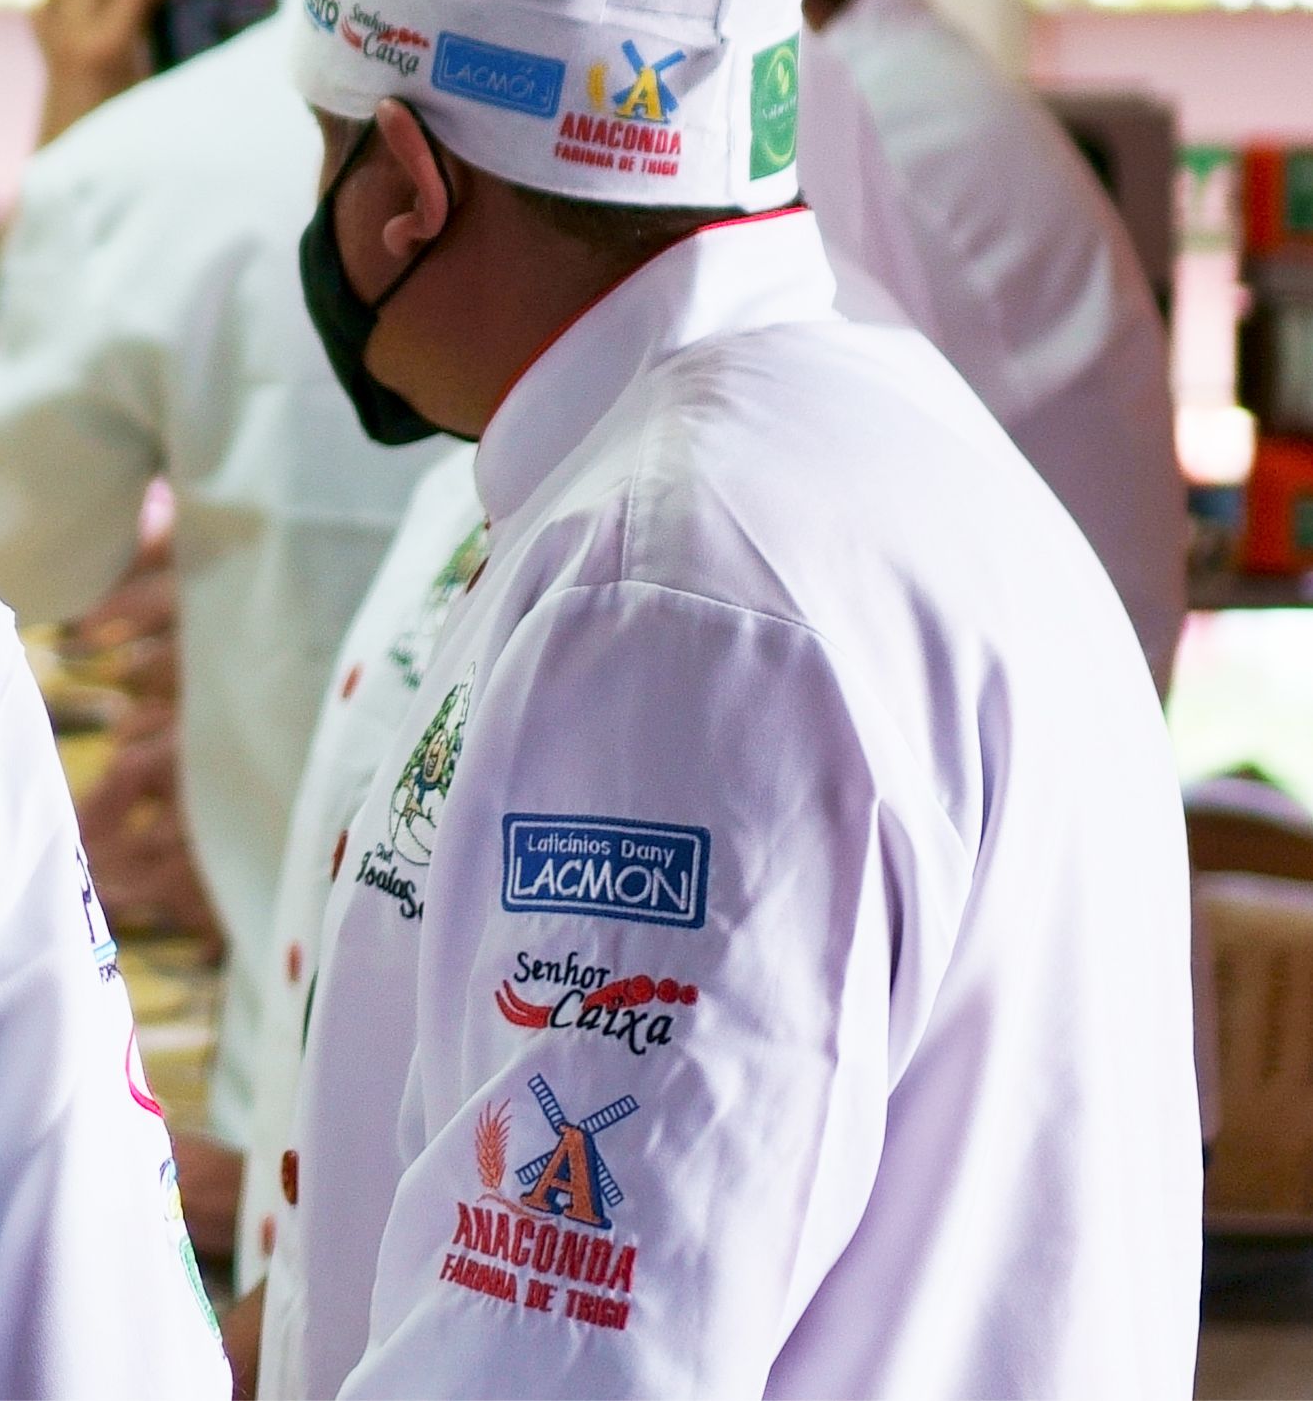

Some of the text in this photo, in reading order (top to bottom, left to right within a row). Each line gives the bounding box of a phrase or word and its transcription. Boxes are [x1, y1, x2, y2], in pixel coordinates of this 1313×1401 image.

[363, 31, 420, 77] Caixa
[559, 111, 682, 155] ANACONDA
[618, 155, 634, 173] DE
[527, 831, 675, 868] Laticínios Dany
[513, 856, 689, 911] LACMON
[513, 950, 612, 989] Senhor
[549, 989, 676, 1056] Caixa
[451, 1201, 637, 1294] ANACONDA
[525, 1278, 559, 1312] DE
